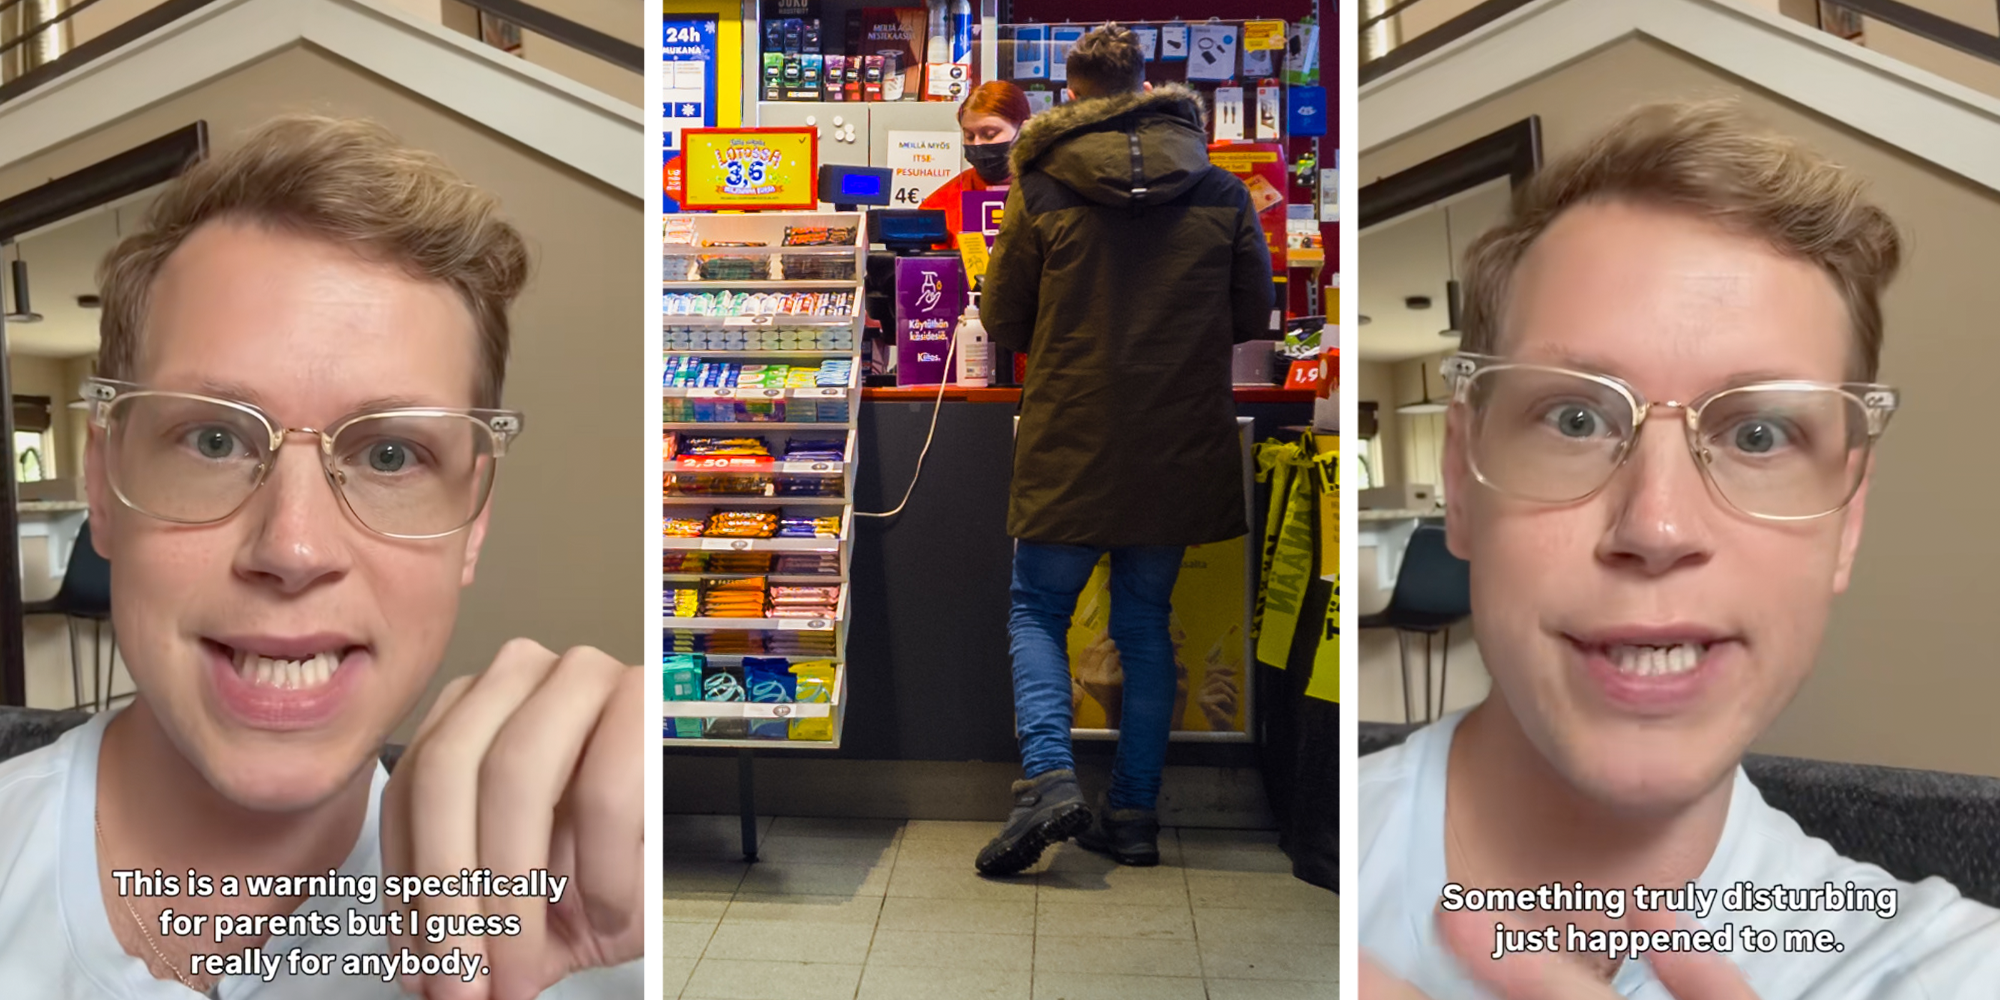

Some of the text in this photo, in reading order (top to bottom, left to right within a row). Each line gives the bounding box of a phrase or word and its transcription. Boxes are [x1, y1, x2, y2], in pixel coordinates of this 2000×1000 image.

[666, 26, 701, 43] 24h
[898, 141, 951, 150] MEILLÄ MYÖS
[715, 146, 782, 169] LOTOSSA
[912, 154, 935, 163] ITSE-
[725, 161, 764, 187] 3,6
[896, 168, 951, 177] PESUHALLIT
[894, 187, 920, 204] 4€
[1295, 368, 1319, 384] 1,9
[683, 458, 729, 468] 2,50
